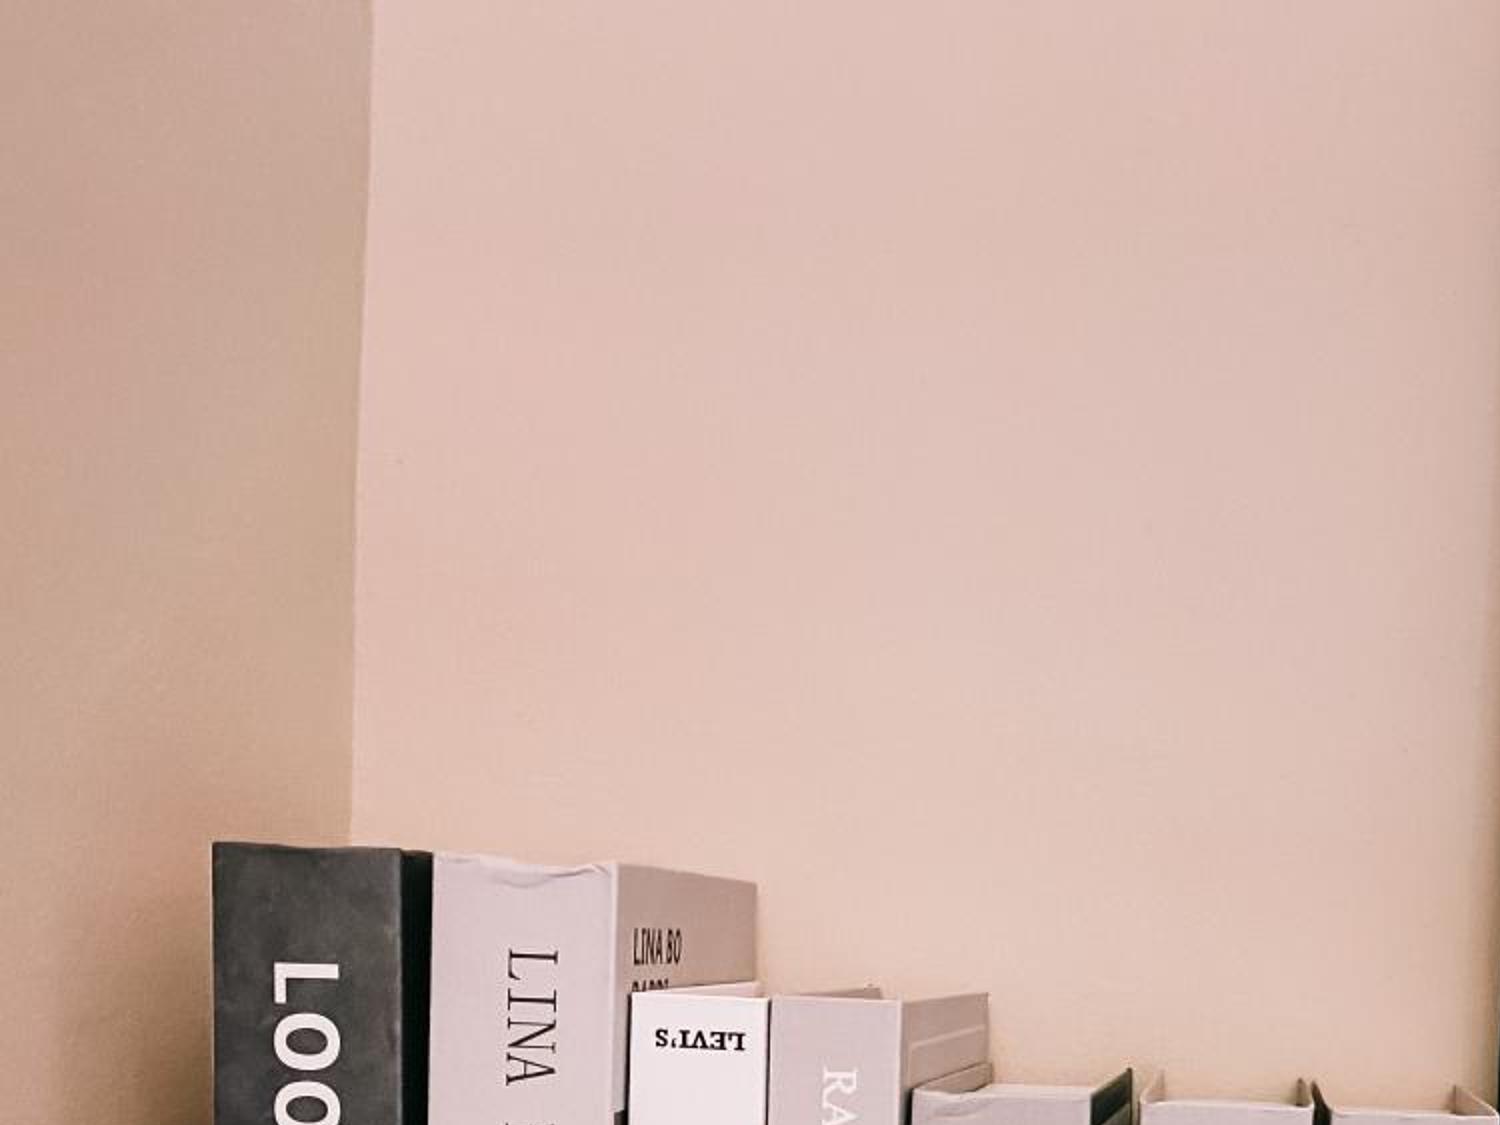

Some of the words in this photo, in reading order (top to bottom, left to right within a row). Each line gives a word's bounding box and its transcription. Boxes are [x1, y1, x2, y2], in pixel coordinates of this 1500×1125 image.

[633, 927, 663, 966] LINA
[666, 928, 682, 965] BO
[505, 949, 559, 1086] LINA
[655, 1027, 747, 1052] LEVI'S
